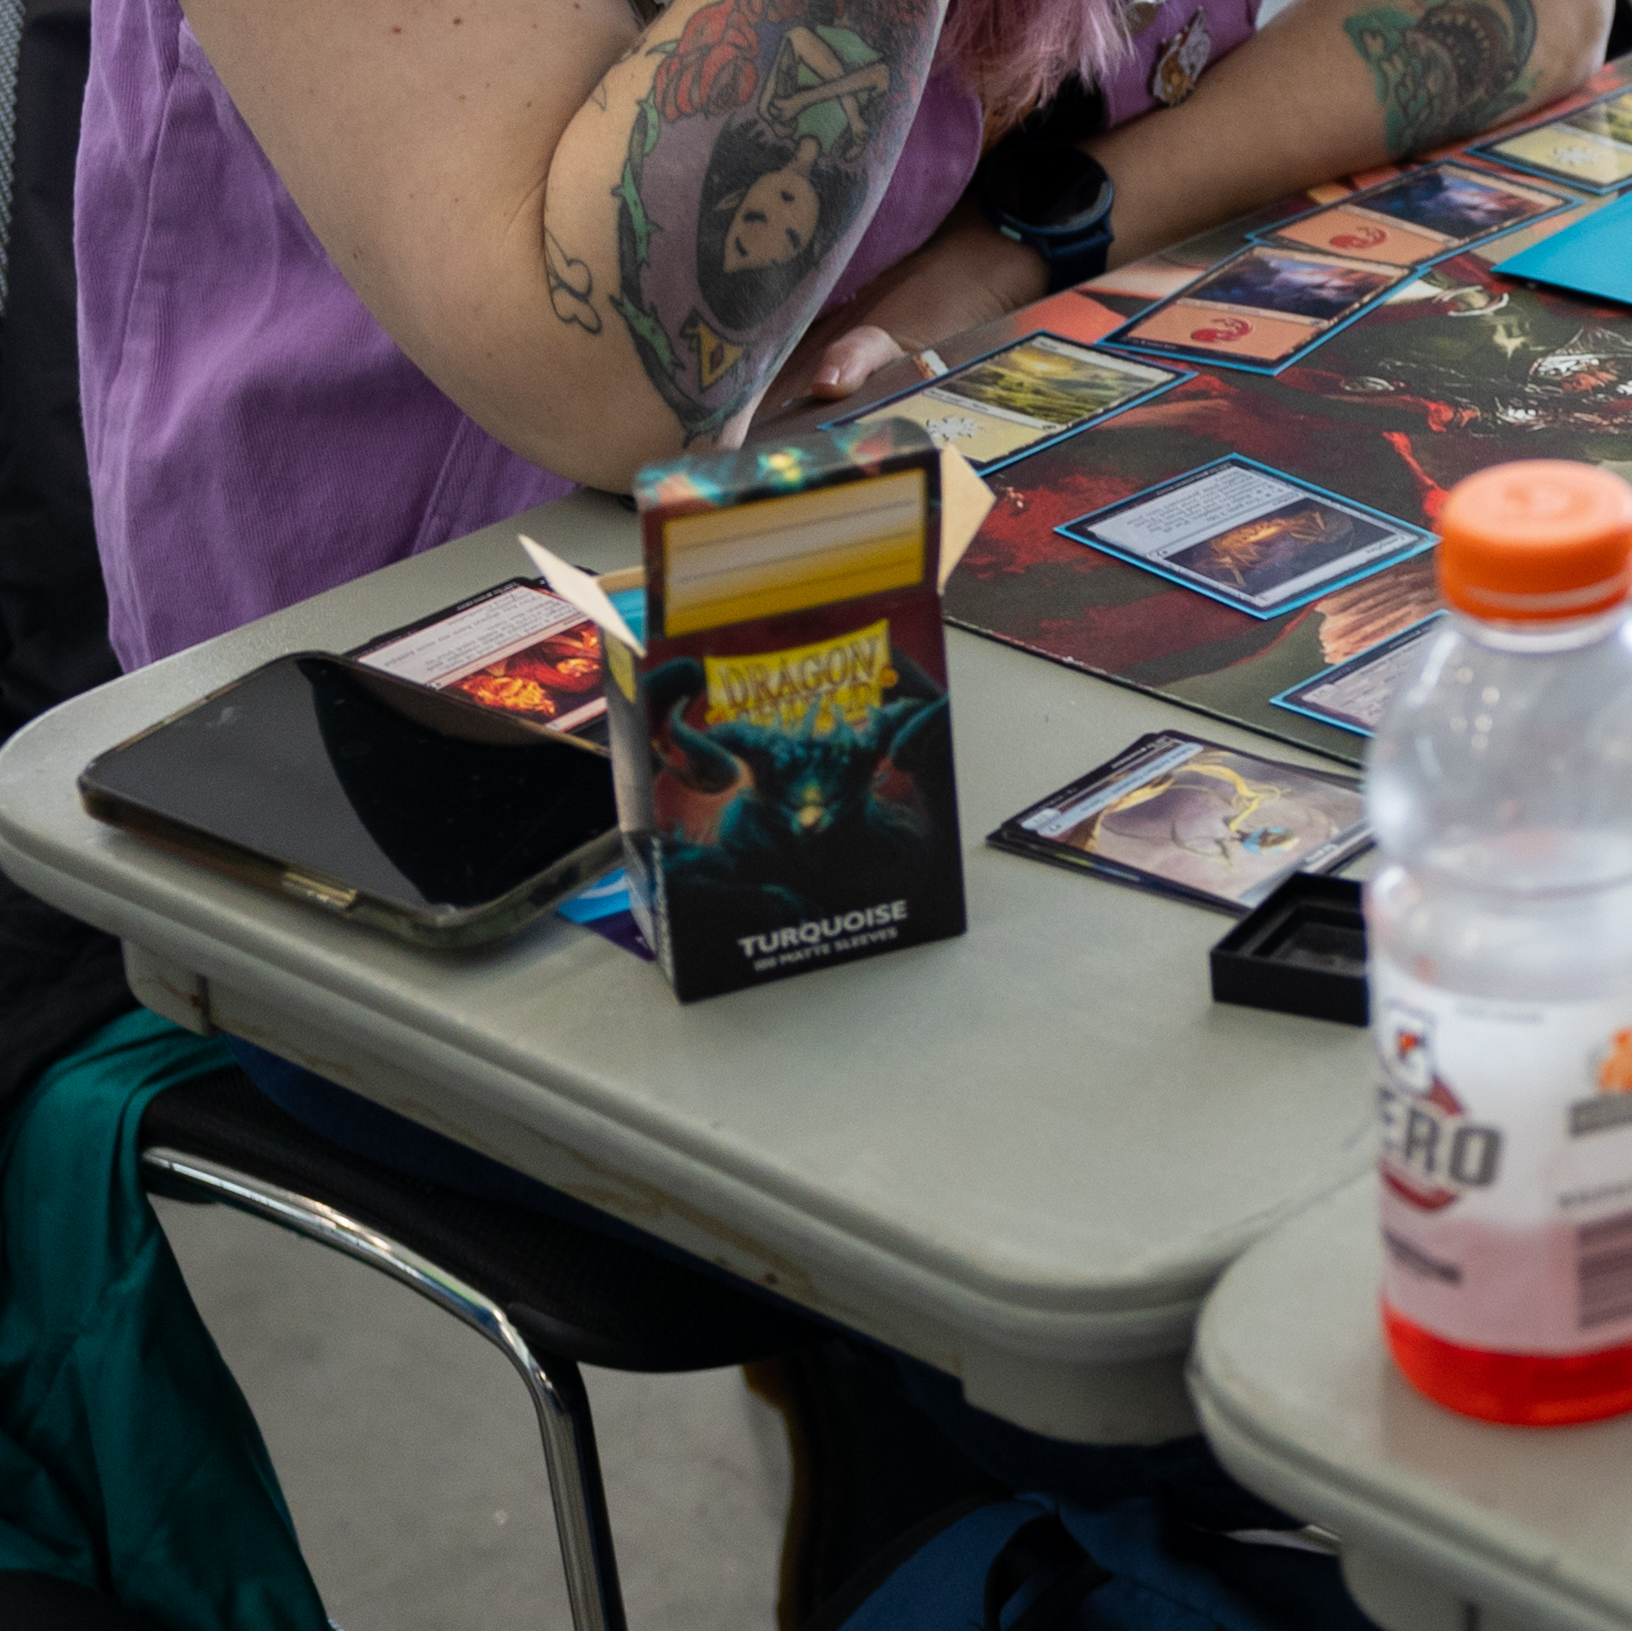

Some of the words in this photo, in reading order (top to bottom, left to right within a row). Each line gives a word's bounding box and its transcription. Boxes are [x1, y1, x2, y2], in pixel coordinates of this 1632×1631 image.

[719, 635, 880, 710] DRAGON
[737, 899, 907, 958] TURQUOISE
[779, 943, 831, 965] MATTE
[835, 926, 898, 952] SLEEVES
[1378, 1085, 1503, 1190] ERO
